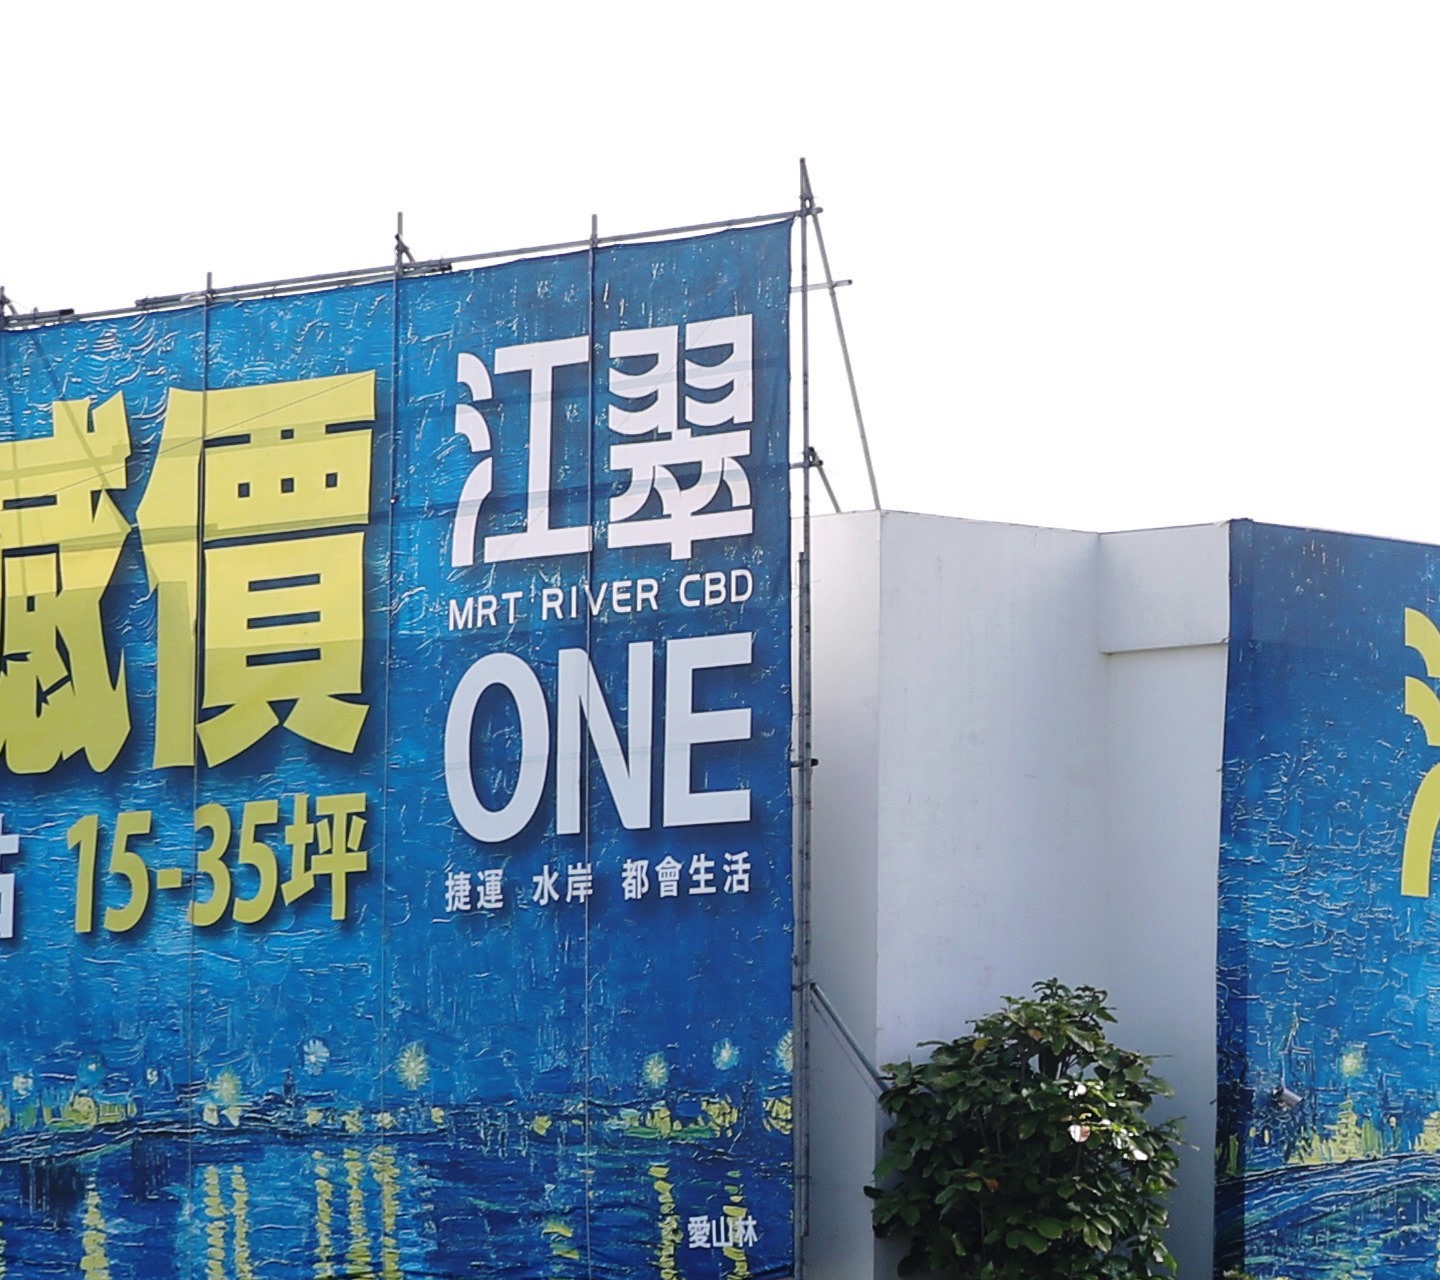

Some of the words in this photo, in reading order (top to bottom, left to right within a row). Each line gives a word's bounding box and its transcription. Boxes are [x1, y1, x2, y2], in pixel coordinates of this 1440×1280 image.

[451, 314, 755, 568] 江翠
[448, 592, 524, 632] MRT
[541, 578, 660, 621] RIVER
[678, 569, 754, 608] CBD
[444, 631, 752, 844] ONE
[68, 793, 368, 935] 15-35坪
[445, 869, 505, 913] 捷運
[532, 861, 594, 905] 水岸
[621, 851, 752, 901] 都會生活
[687, 1215, 759, 1248] 愛山林
